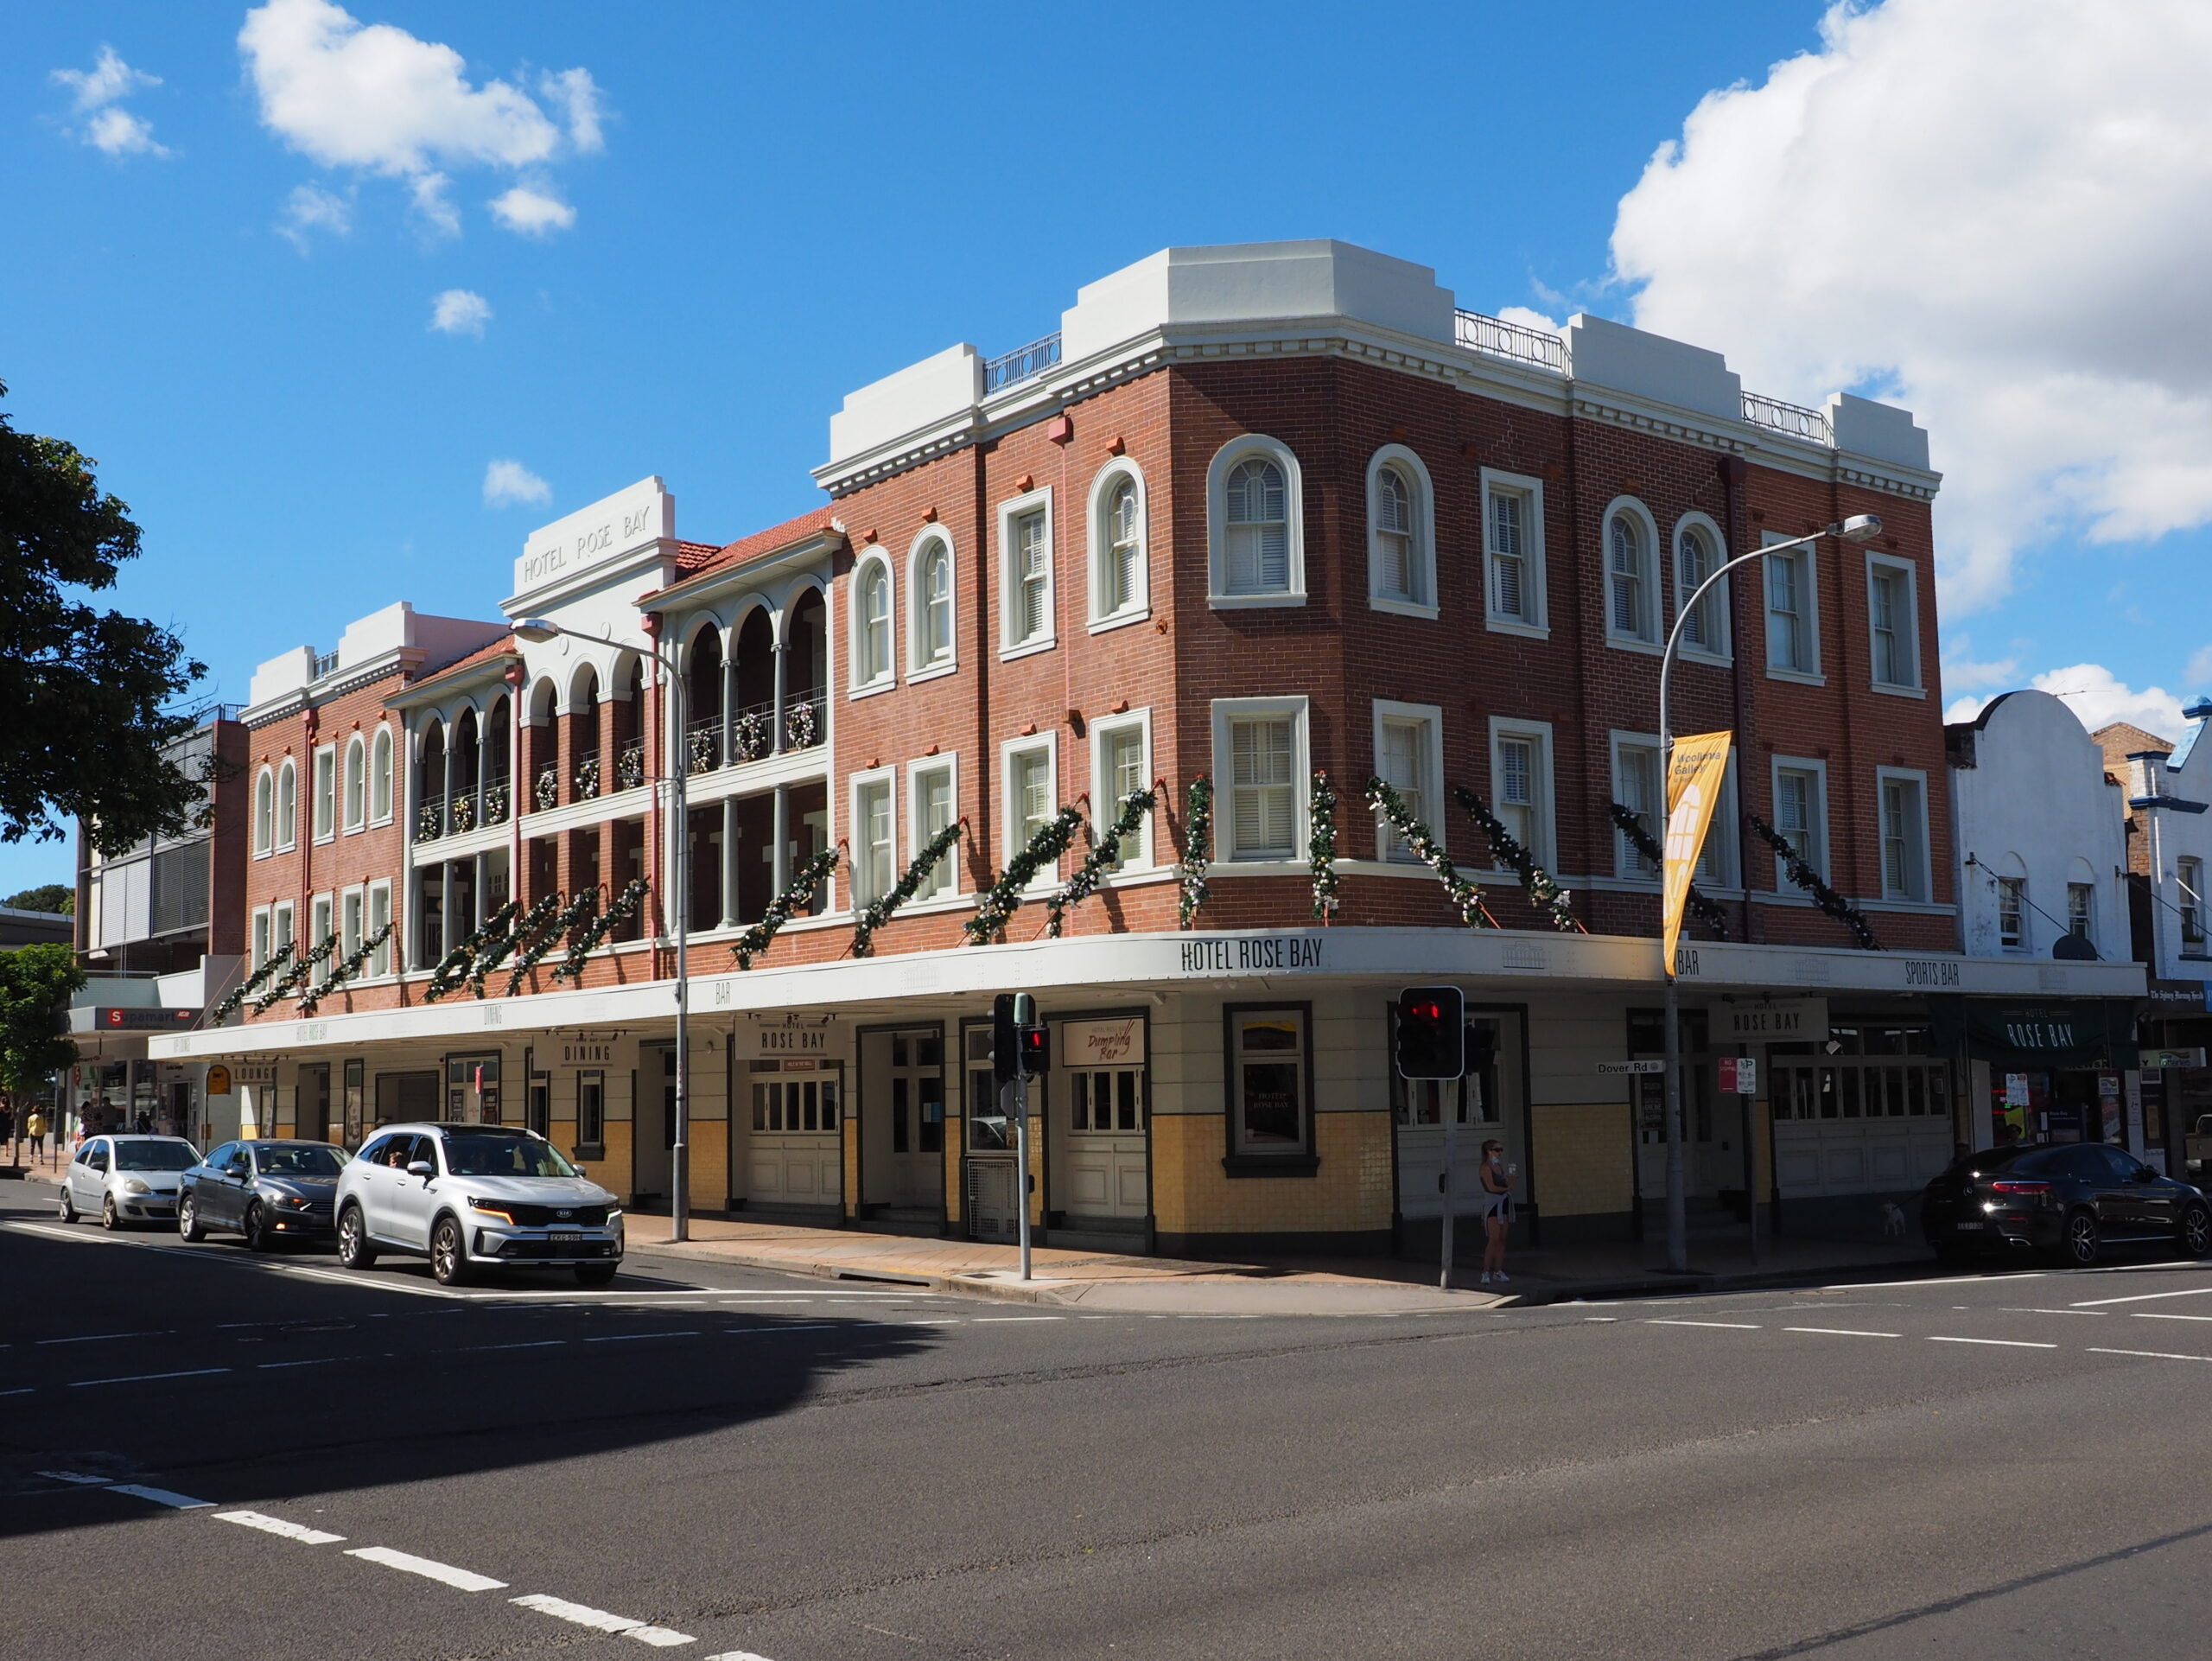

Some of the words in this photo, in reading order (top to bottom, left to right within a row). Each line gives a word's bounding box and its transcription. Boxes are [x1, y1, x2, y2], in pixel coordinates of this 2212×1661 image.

[524, 545, 567, 582] HOTEL
[577, 525, 613, 559] ROSE
[623, 506, 650, 538] BAY
[1182, 941, 1233, 971] HOTEL
[1239, 939, 1283, 969] ROSE
[1290, 938, 1323, 967] BAY
[1677, 950, 1700, 976] BAR
[1905, 961, 1938, 985] SPORTS
[1941, 963, 1960, 986] BAR
[715, 982, 731, 1005] BAR
[1734, 1015, 1766, 1031] ROSE
[1776, 1013, 1800, 1030] BAY
[2025, 1009, 2049, 1019] HOTEL
[762, 1032, 793, 1048] ROSE
[802, 1032, 825, 1048] BAY
[1088, 1032, 1131, 1056] Dumpling
[2006, 1023, 2044, 1047] ROSE
[2048, 1023, 2075, 1047] BAY
[564, 1046, 610, 1060] DINING
[1098, 1047, 1118, 1061] Bar
[1599, 1064, 1629, 1074] Dover
[1634, 1062, 1648, 1072] Rd
[1258, 1091, 1284, 1100] HOTEL
